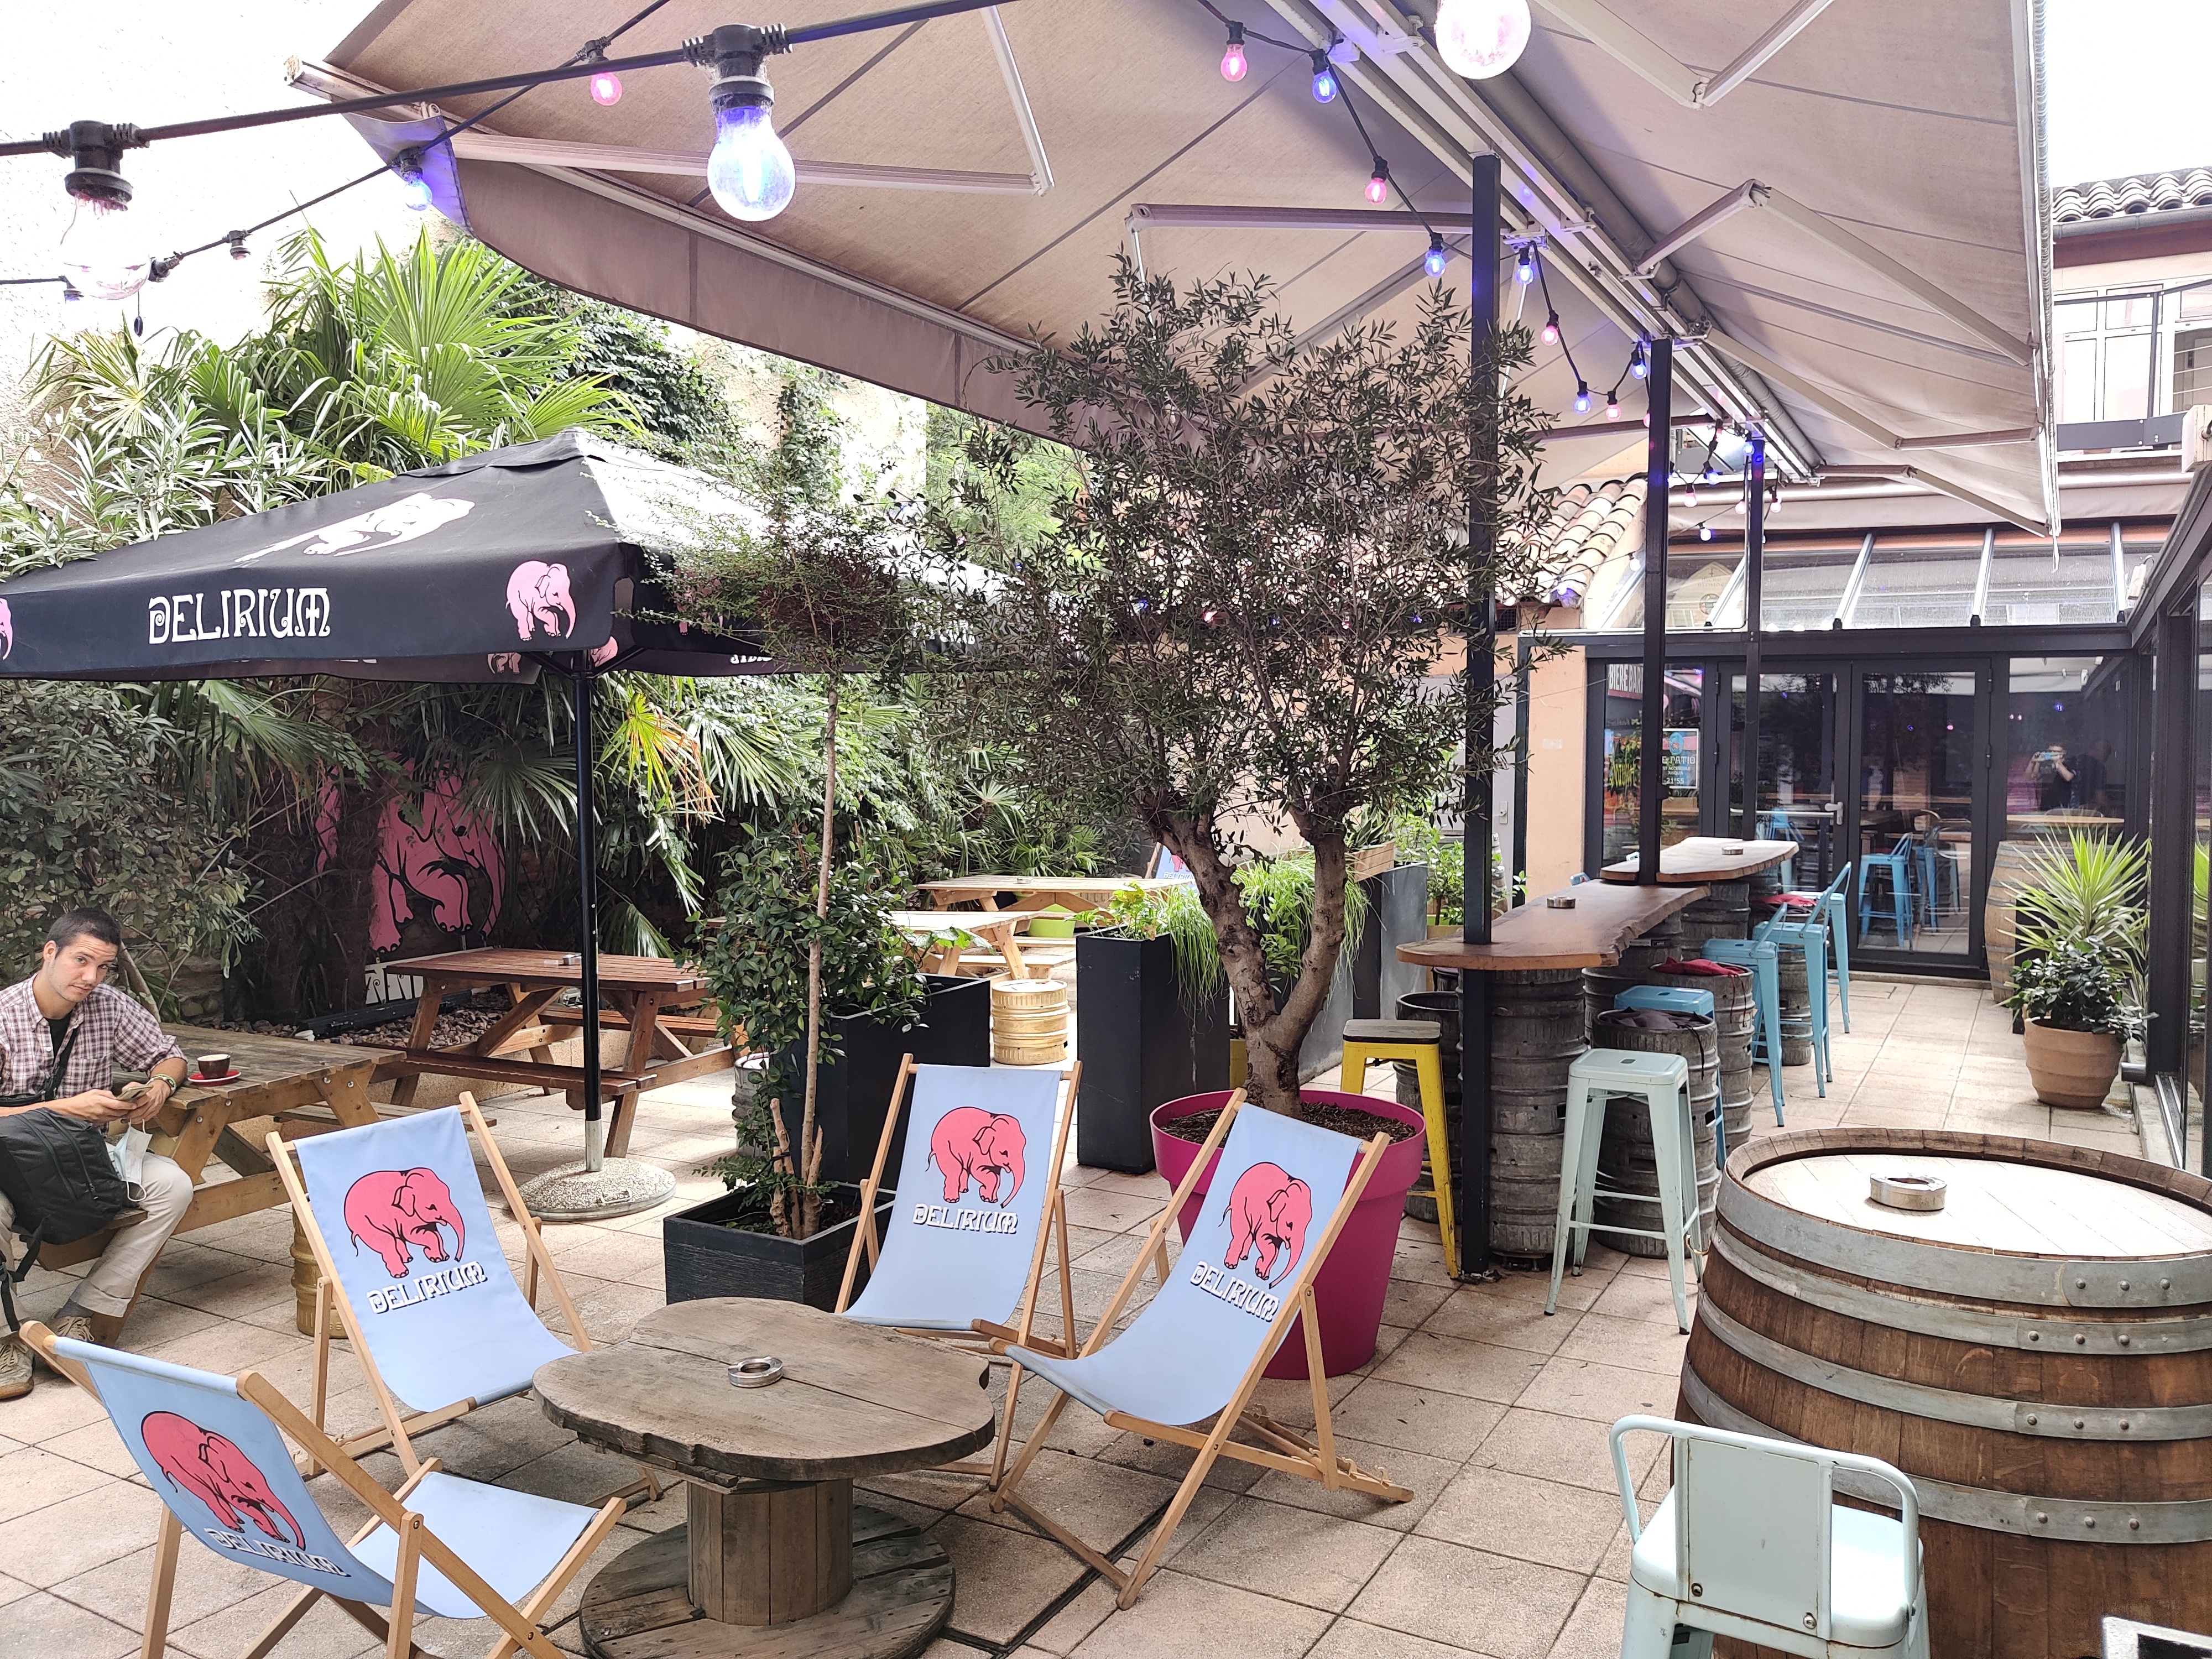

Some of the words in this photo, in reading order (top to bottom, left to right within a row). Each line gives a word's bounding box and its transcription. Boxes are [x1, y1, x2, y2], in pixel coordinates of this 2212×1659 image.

[148, 588, 331, 644] DELIRIUM
[1662, 755, 1668, 764] E
[1670, 755, 1695, 765] PATIO
[912, 1203, 1019, 1235] DELIRIUM
[366, 1260, 488, 1314] DELIRIUM
[1190, 1260, 1280, 1323] DELIRIUM
[204, 1527, 352, 1578] DELIRIUM
